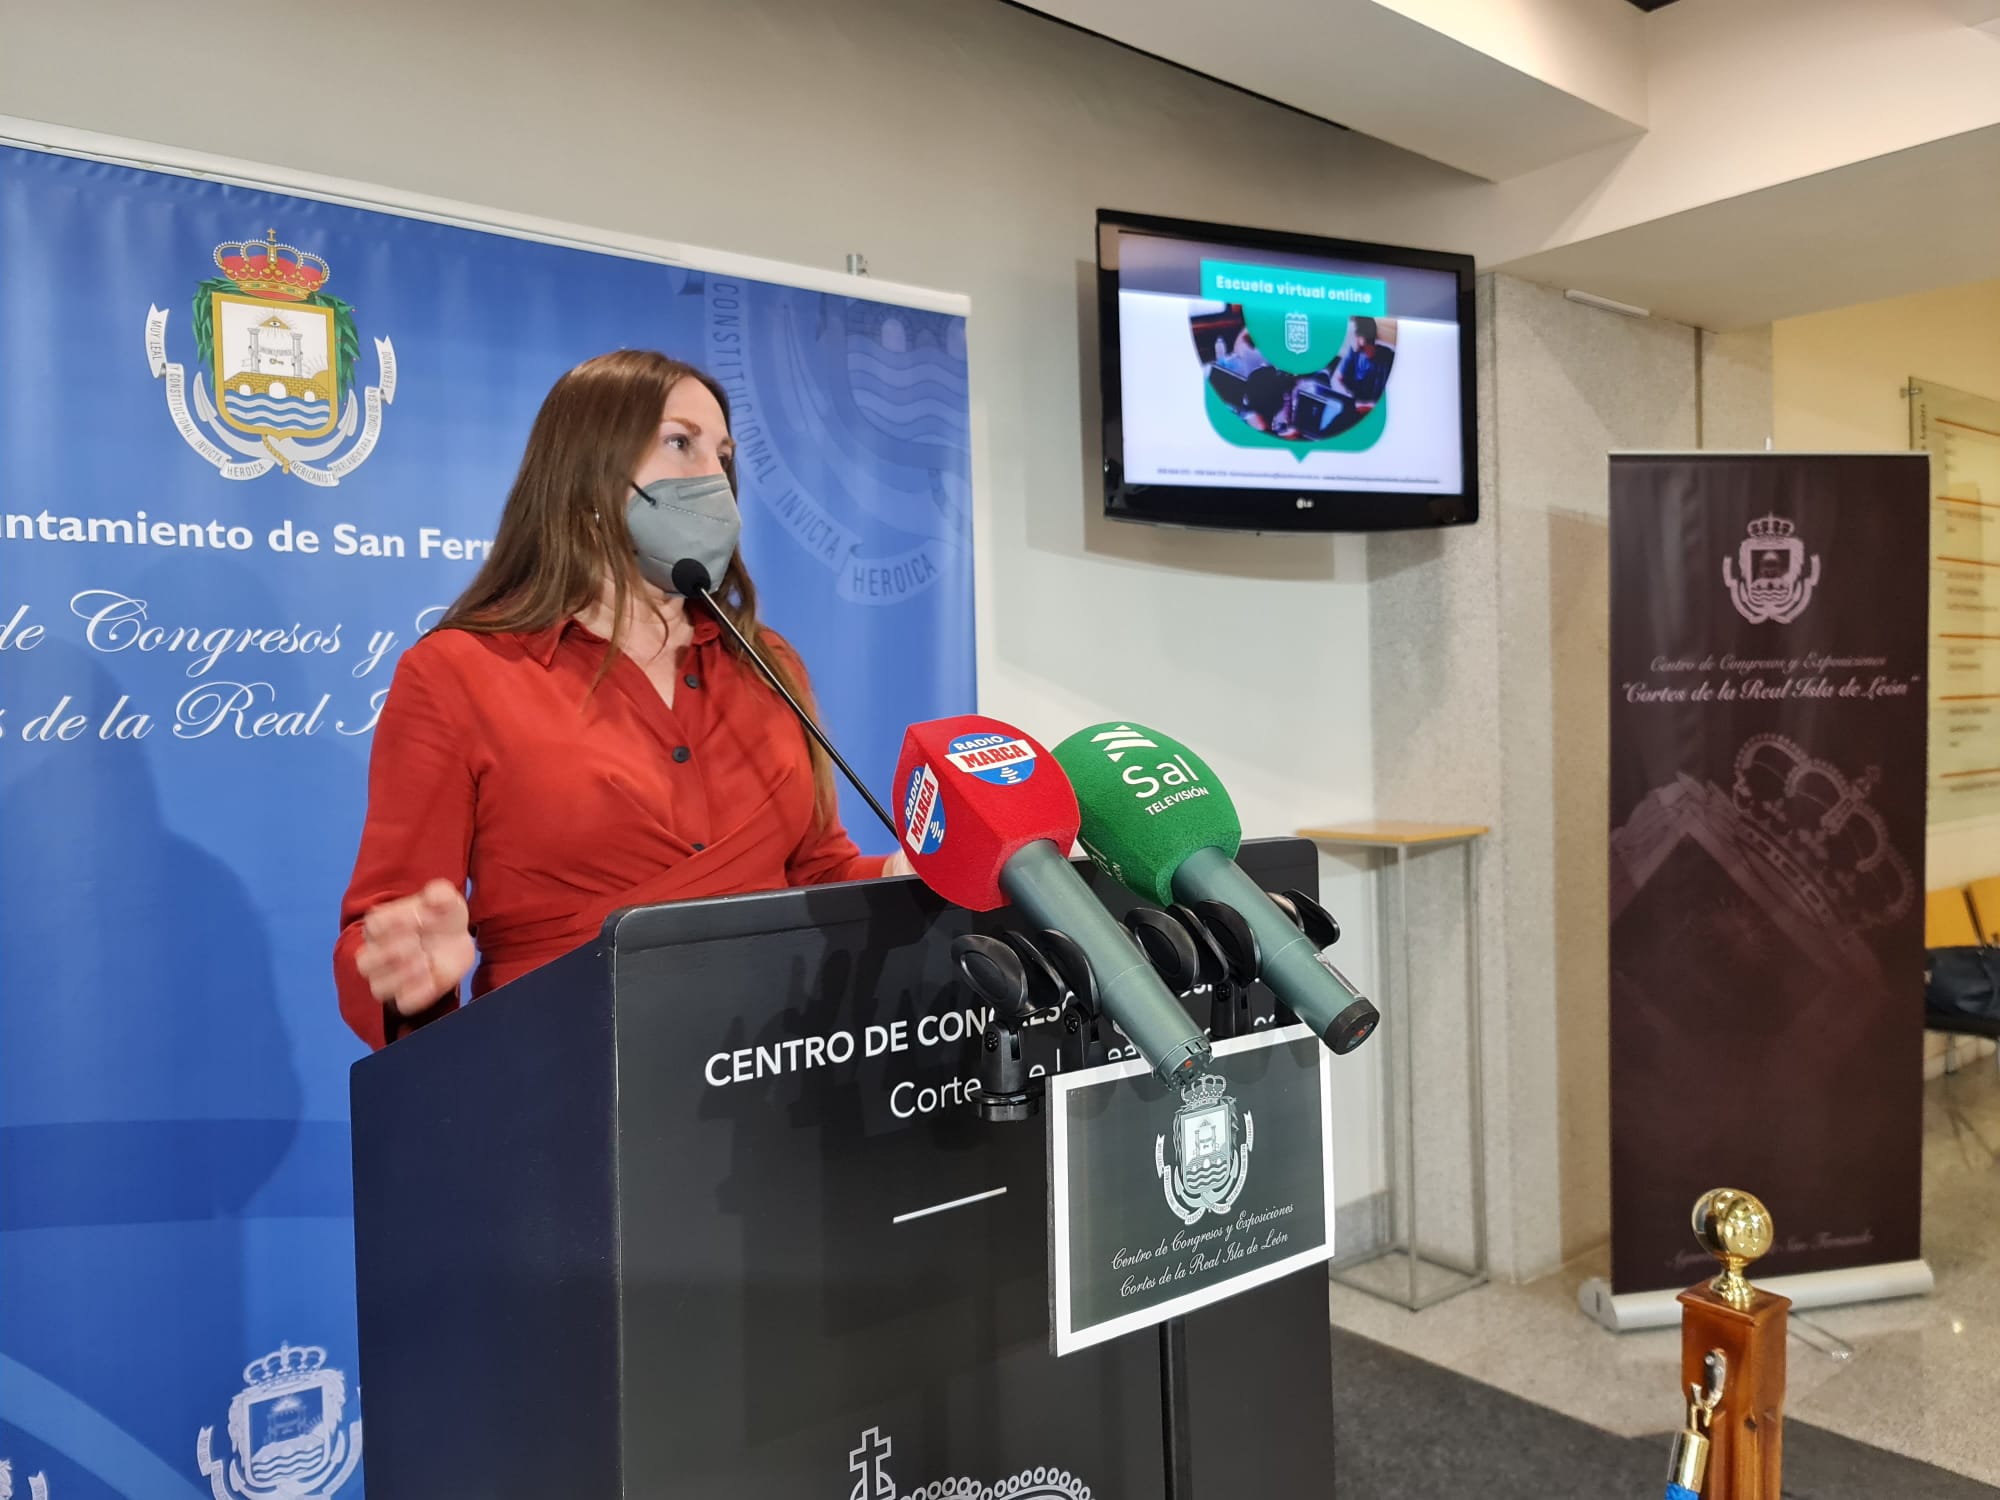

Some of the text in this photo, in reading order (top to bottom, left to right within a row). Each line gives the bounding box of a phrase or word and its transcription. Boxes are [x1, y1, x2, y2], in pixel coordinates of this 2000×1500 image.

[1215, 274, 1373, 304] Escuela virtual online
[0, 509, 253, 550] ntamiento
[268, 520, 320, 554] de
[333, 523, 406, 558] San
[775, 488, 842, 560] INVICTA
[853, 553, 938, 596] HEROICA
[70, 590, 341, 678] Congresos
[351, 629, 400, 678] y
[21, 696, 88, 742] de
[99, 695, 155, 741] la
[172, 681, 332, 739] Real
[1690, 680, 1714, 702] de
[1717, 679, 1736, 702] la
[1739, 677, 1793, 701] Real
[1838, 675, 1862, 698] de
[953, 735, 1004, 751] RADIO
[962, 744, 1028, 769] MARCA
[905, 770, 921, 820] RADIO
[1122, 754, 1200, 799] Sal
[1144, 785, 1210, 817] TELEVISIÓN
[910, 777, 936, 844] MARCA
[704, 1031, 855, 1087] CENTRO
[865, 1020, 909, 1057] DE
[889, 1076, 982, 1118] Corte
[1111, 1203, 1295, 1270] Centro de Congresos y Exposiciones
[1119, 1228, 1289, 1297] Cortes de la Real Isla de León
